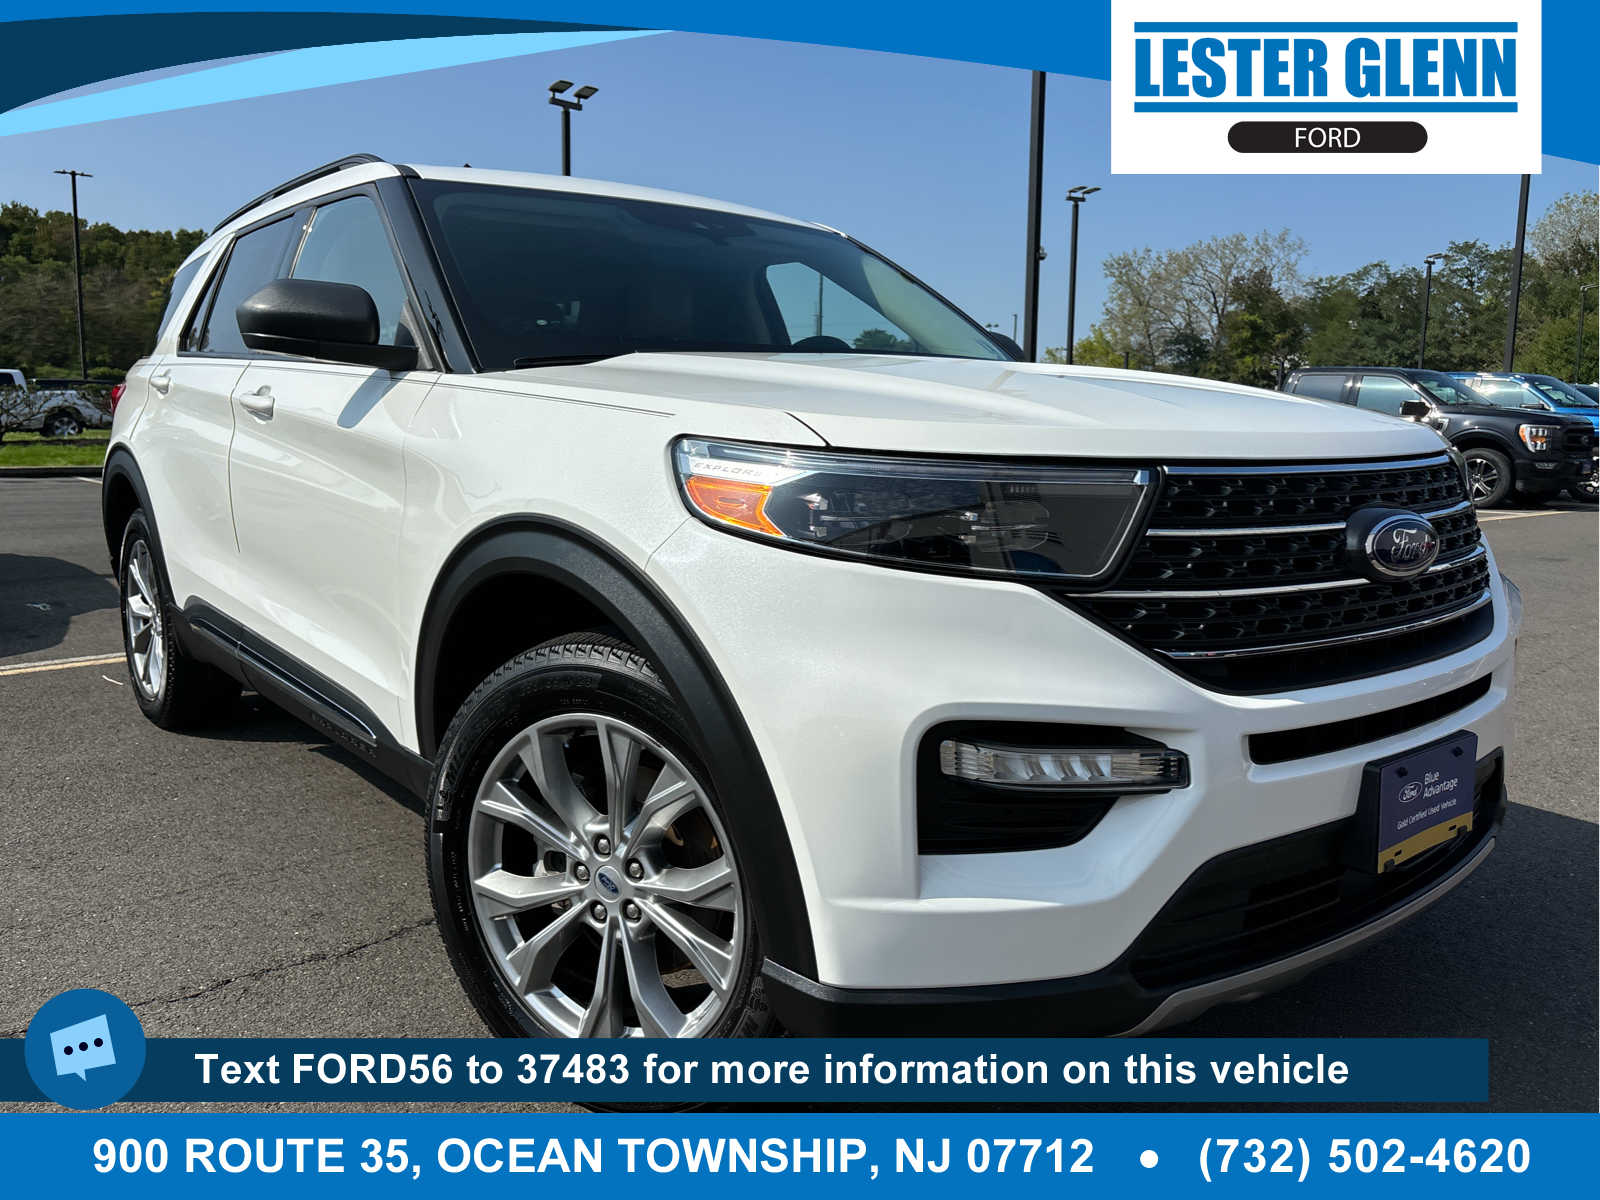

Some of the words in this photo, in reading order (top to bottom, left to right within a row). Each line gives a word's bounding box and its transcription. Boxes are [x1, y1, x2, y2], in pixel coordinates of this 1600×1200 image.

[1391, 528, 1435, 562] Ford
[1424, 771, 1440, 785] Blue
[1402, 784, 1419, 801] Ford
[1422, 778, 1458, 799] Advantage
[1428, 804, 1440, 815] Used
